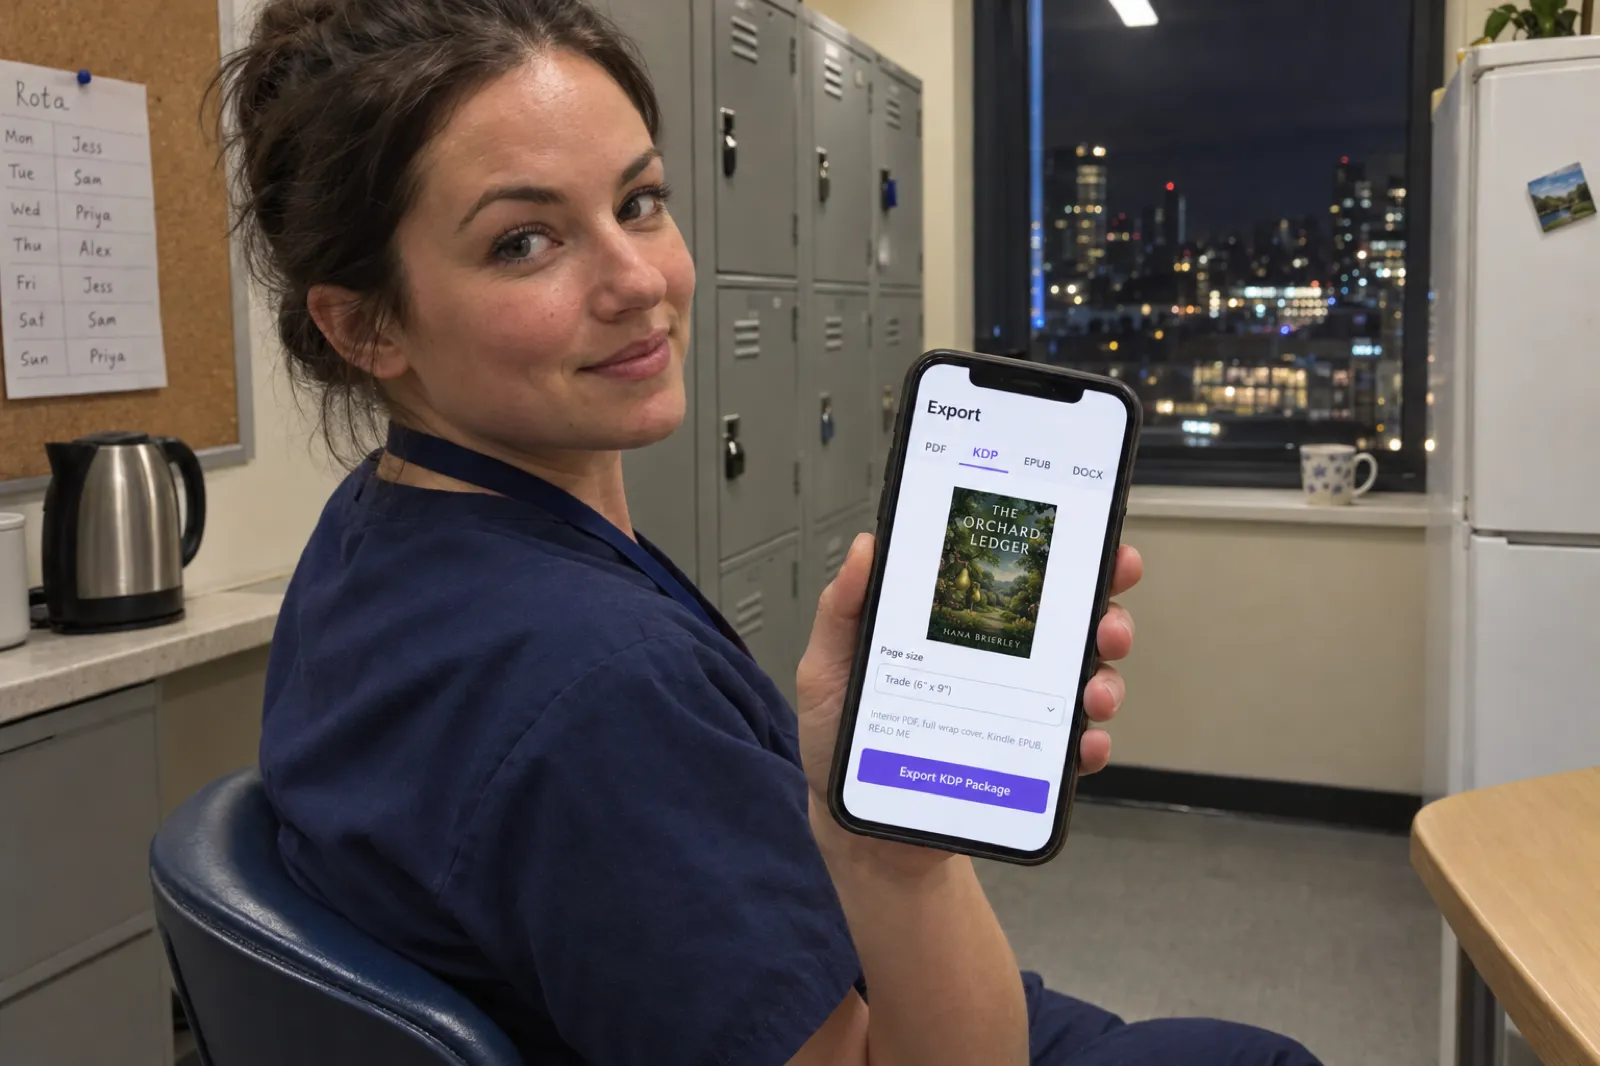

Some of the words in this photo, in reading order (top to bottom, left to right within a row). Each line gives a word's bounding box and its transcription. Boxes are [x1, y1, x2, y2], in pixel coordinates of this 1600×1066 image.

[15, 80, 70, 111] Rota
[6, 130, 33, 144] Mon
[72, 136, 102, 154] Jess
[8, 164, 35, 180] Tue
[74, 169, 102, 185] Sam
[11, 202, 41, 217] Wed
[76, 204, 112, 228] Priya
[13, 237, 42, 252] Thu
[79, 240, 112, 257] Alex
[17, 275, 36, 290] Fri
[84, 276, 113, 294] Jess
[19, 312, 45, 328] Sat
[88, 311, 116, 328] Sam
[21, 351, 48, 367] Sun
[90, 348, 126, 370] Priya
[927, 400, 981, 422] Export
[925, 442, 946, 454] PDF
[972, 447, 998, 460] KDP
[1024, 457, 1050, 470] EPUB
[1072, 466, 1104, 480] DOCX
[992, 504, 1018, 518] THE
[963, 516, 1040, 540] ORCHARD
[970, 534, 1029, 555] LEDGER
[943, 628, 970, 640] HANA
[975, 634, 1020, 648] BRIERLEY
[880, 646, 904, 660] Page
[906, 650, 924, 662] size
[885, 674, 910, 687] Trade
[914, 680, 928, 690] (6"
[937, 684, 952, 696] 9")
[868, 724, 894, 736] READ
[896, 729, 910, 738] ME
[870, 710, 900, 722] Interior
[902, 716, 920, 727] PDF,
[922, 718, 936, 730] full
[938, 724, 959, 735] wrap
[961, 728, 984, 740] cover,
[987, 732, 1015, 745] Kindle
[1018, 738, 1043, 751] EPUB,
[900, 766, 936, 782] Export
[940, 774, 963, 786] KDP
[966, 778, 1011, 797] Package
